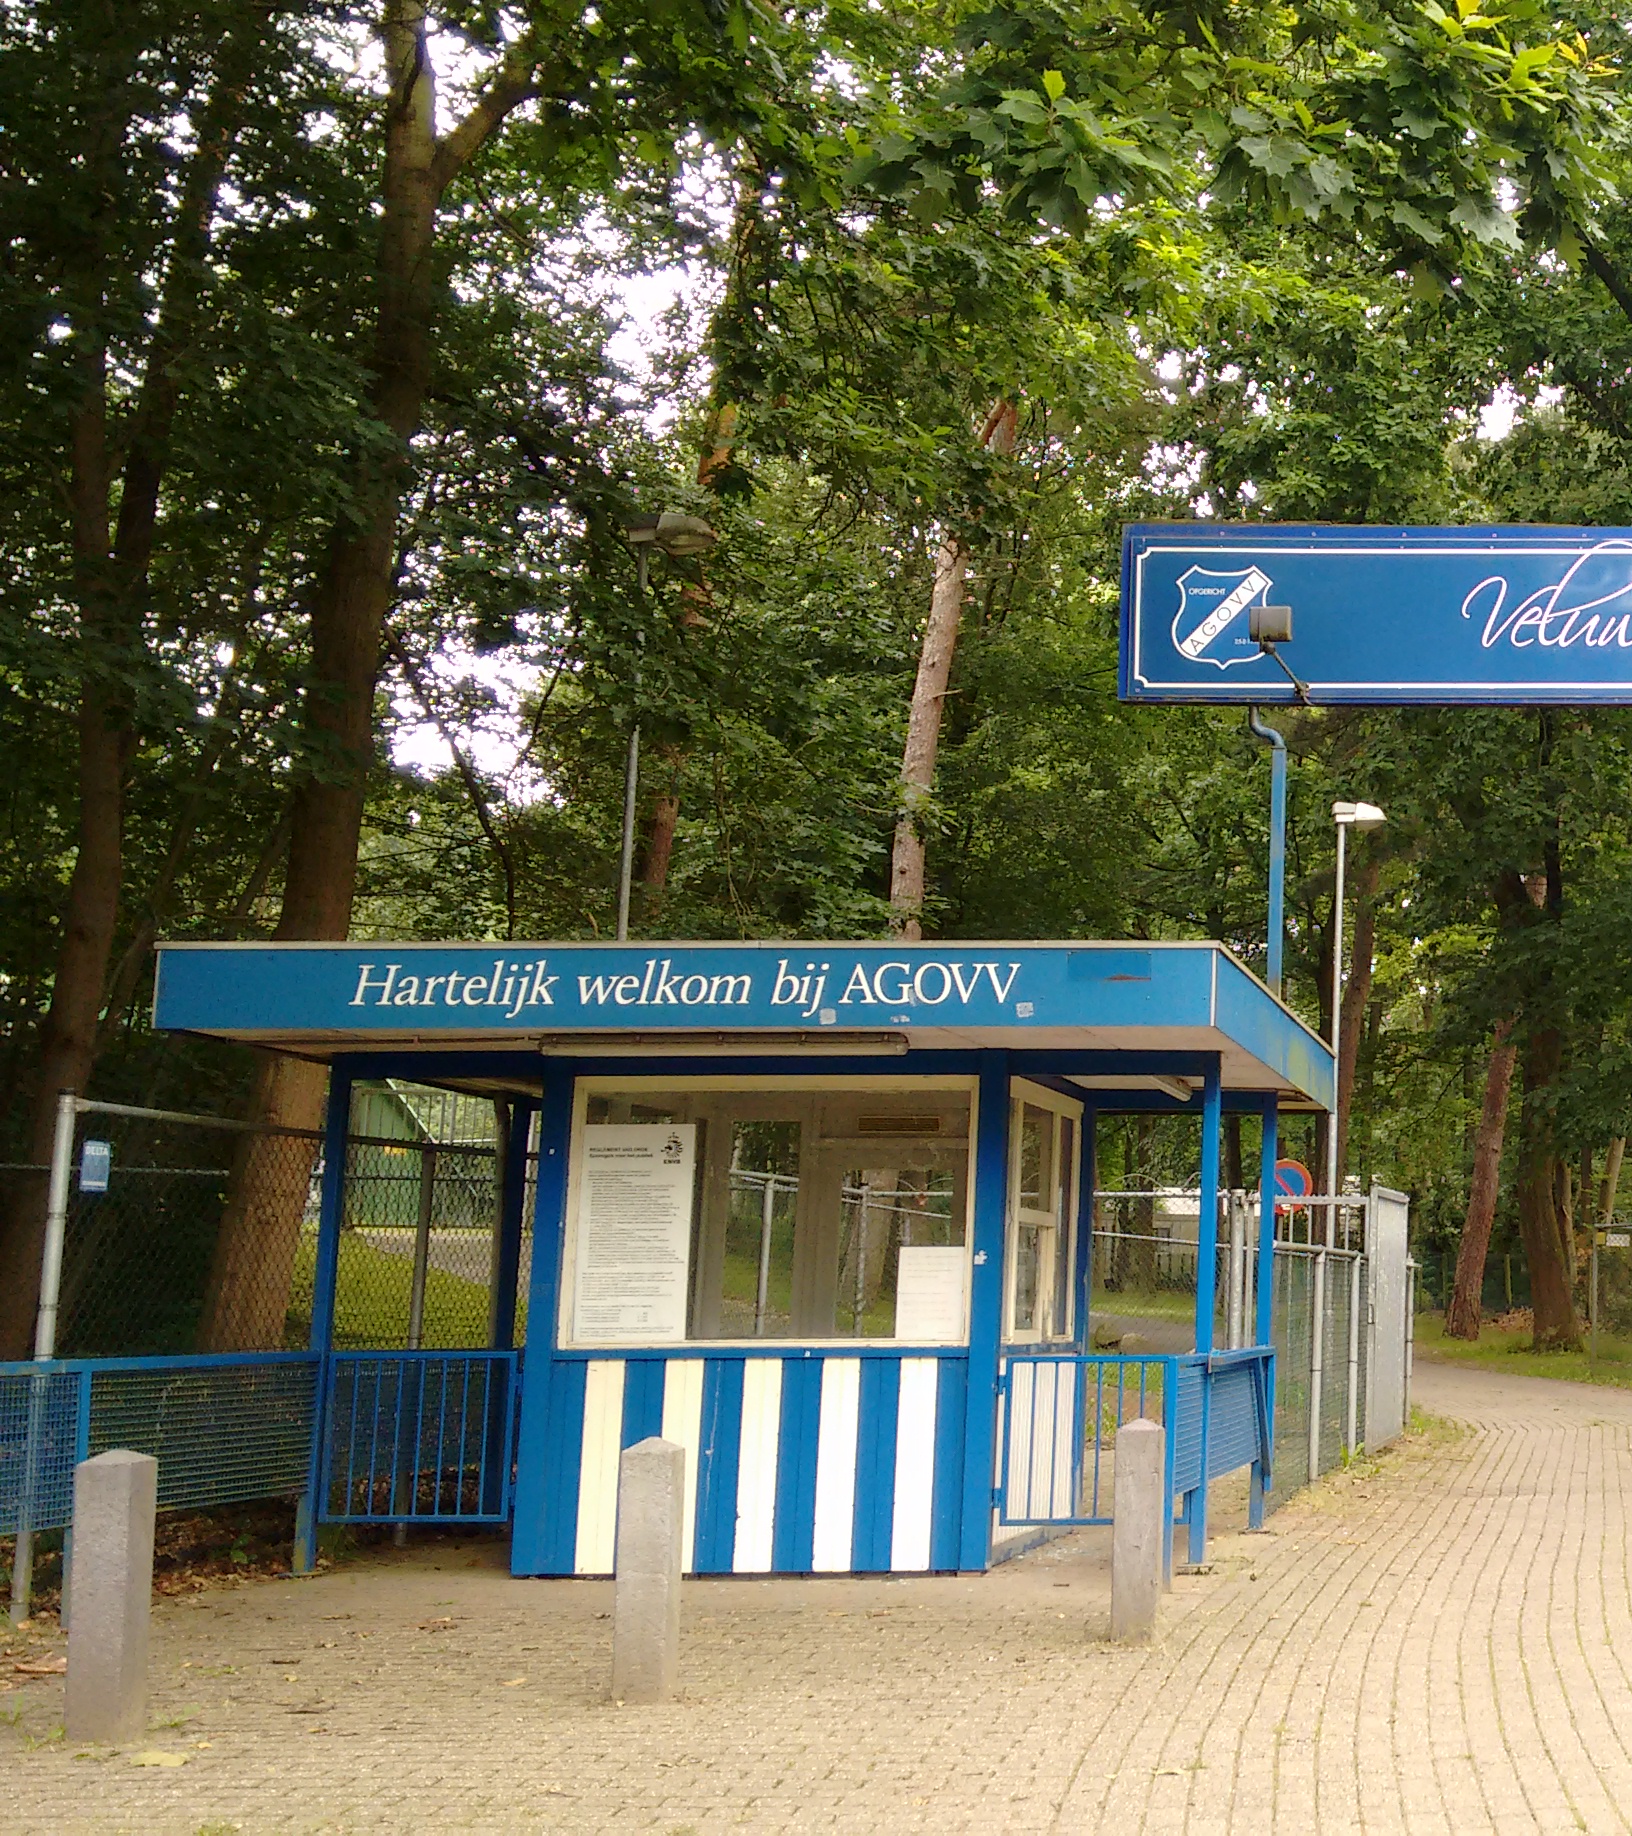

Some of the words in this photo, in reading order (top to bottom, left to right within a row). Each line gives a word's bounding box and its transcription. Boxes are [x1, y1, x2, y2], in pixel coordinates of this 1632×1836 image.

[1189, 579, 1256, 653] AGOVV
[349, 959, 560, 1019] Hartelijk
[578, 958, 752, 1006] welkom
[770, 958, 831, 1019] bij
[838, 962, 1022, 1007] AGOVV
[85, 1145, 109, 1156] DELTA
